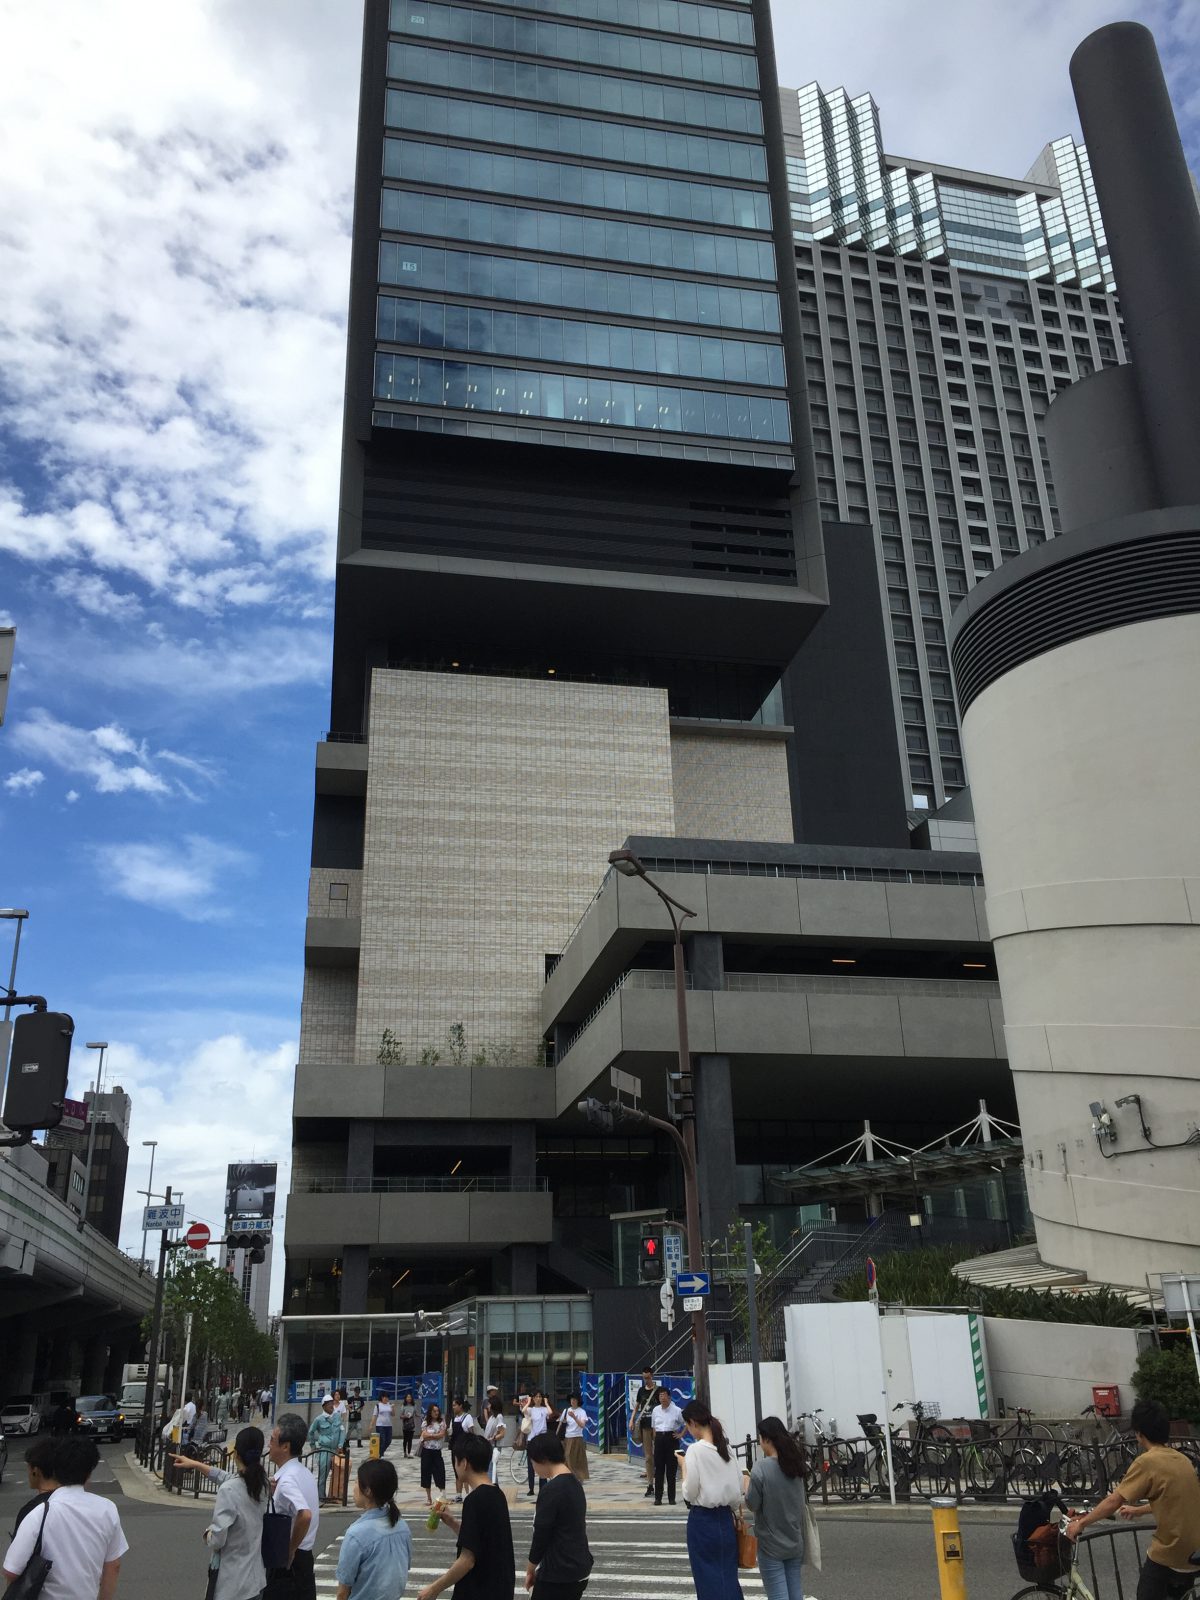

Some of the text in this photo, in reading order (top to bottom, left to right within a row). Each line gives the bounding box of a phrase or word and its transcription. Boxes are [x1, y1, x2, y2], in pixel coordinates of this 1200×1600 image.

[404, 262, 416, 271] 15
[147, 1208, 181, 1220] 難波中
